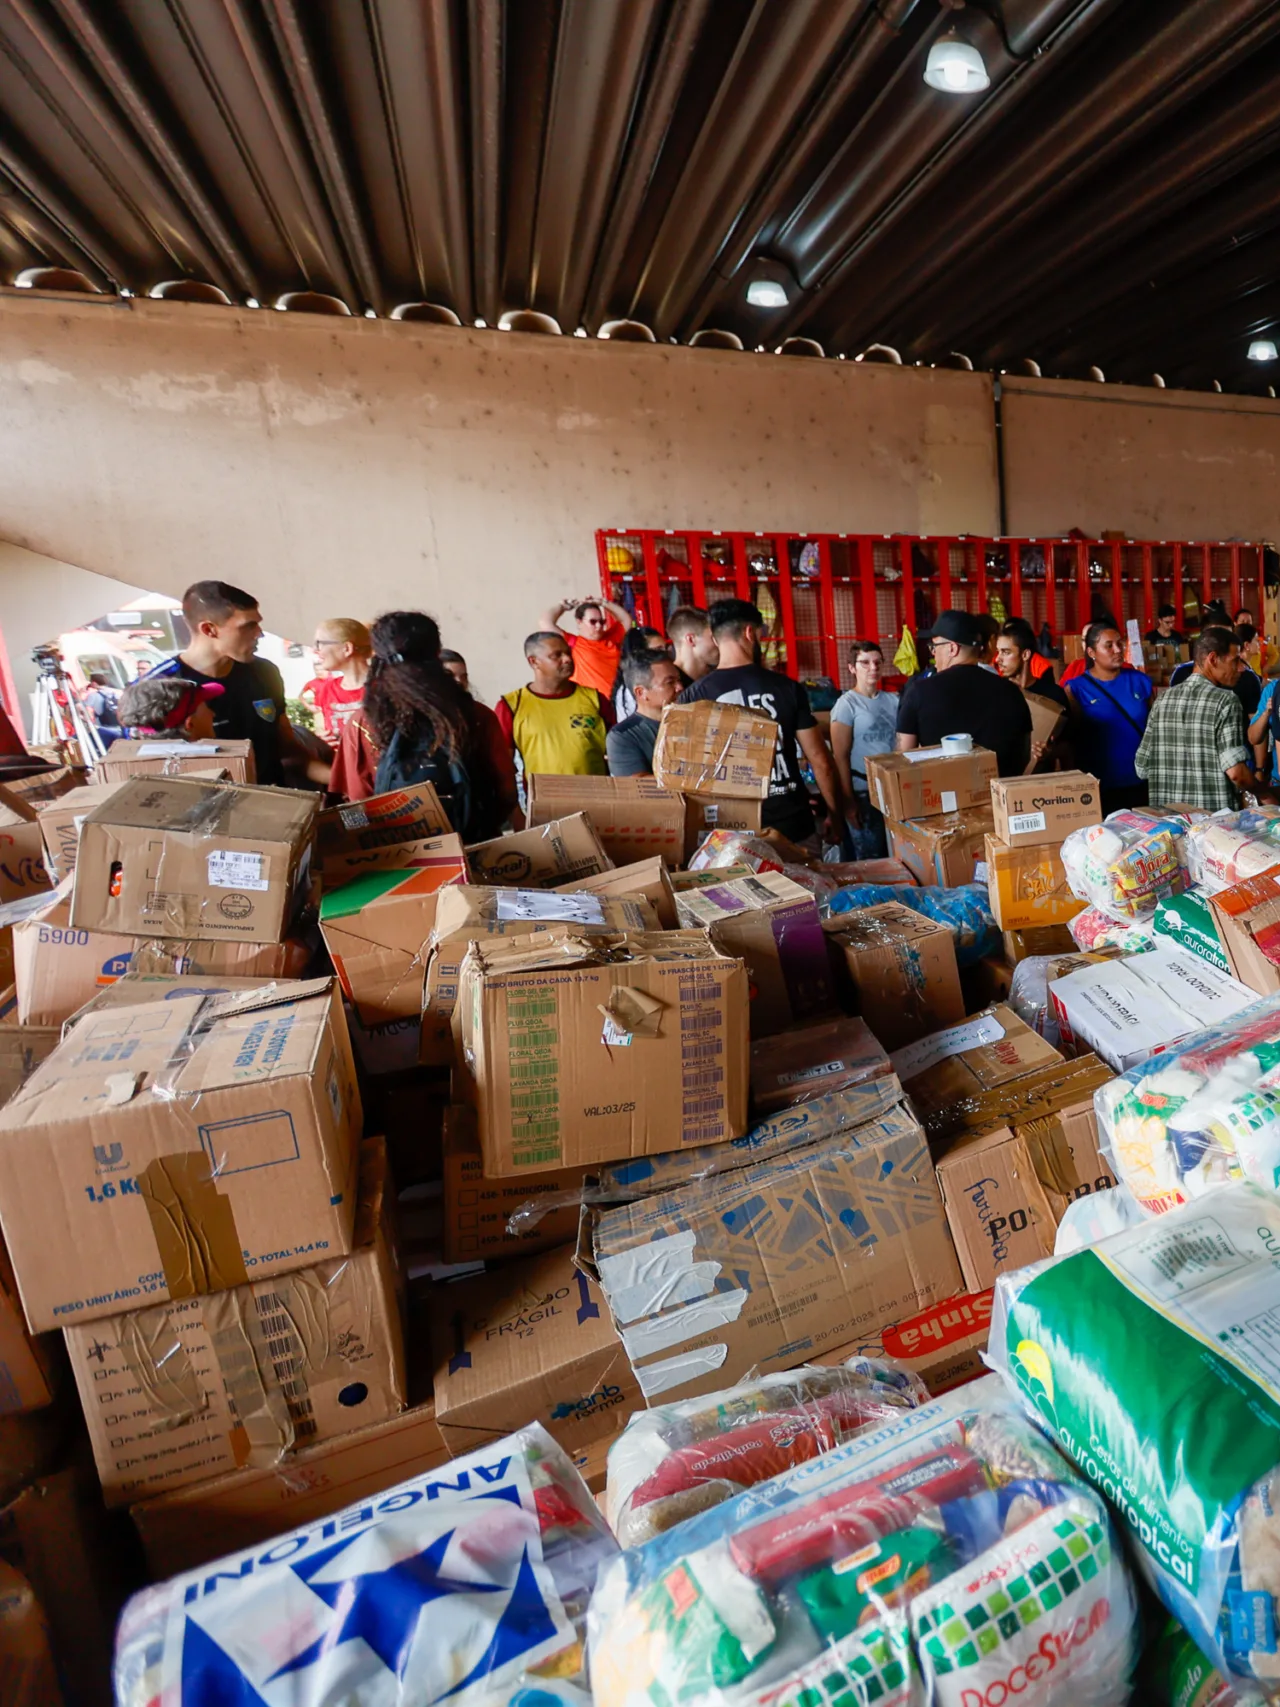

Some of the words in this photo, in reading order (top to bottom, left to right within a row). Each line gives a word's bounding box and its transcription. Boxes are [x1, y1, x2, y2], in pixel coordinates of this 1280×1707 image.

[1032, 796, 1075, 810] Marilan
[38, 928, 89, 946] 5900
[667, 966, 701, 975] FRASCOS
[702, 965, 711, 973] DE
[716, 962, 738, 971] LITRO
[507, 979, 536, 988] BRUTO
[537, 977, 548, 986] DA
[549, 976, 573, 985] CAIXA
[590, 974, 600, 983] kg
[509, 1050, 532, 1059] FLORAL
[584, 1102, 636, 1117] VAL:03/25
[85, 1184, 117, 1203] 1,6
[502, 1182, 560, 1198] TRADICIONAL
[259, 1249, 293, 1265] TOTAL
[293, 1244, 314, 1257] 14,4
[315, 1239, 329, 1254] Kg
[53, 1301, 84, 1317] PESO
[86, 1285, 141, 1310] UNITÁRIO
[142, 1281, 158, 1296] 1,6
[485, 1303, 562, 1341] FRÁGIL
[815, 1311, 875, 1342] 20/02/2025
[899, 1290, 993, 1352] Sinhá
[515, 1326, 535, 1341] T2
[1088, 1434, 1121, 1480] Cestas
[1121, 1474, 1138, 1498] de
[1138, 1494, 1194, 1559] Alimentos
[184, 1455, 513, 1606] ANGELONI
